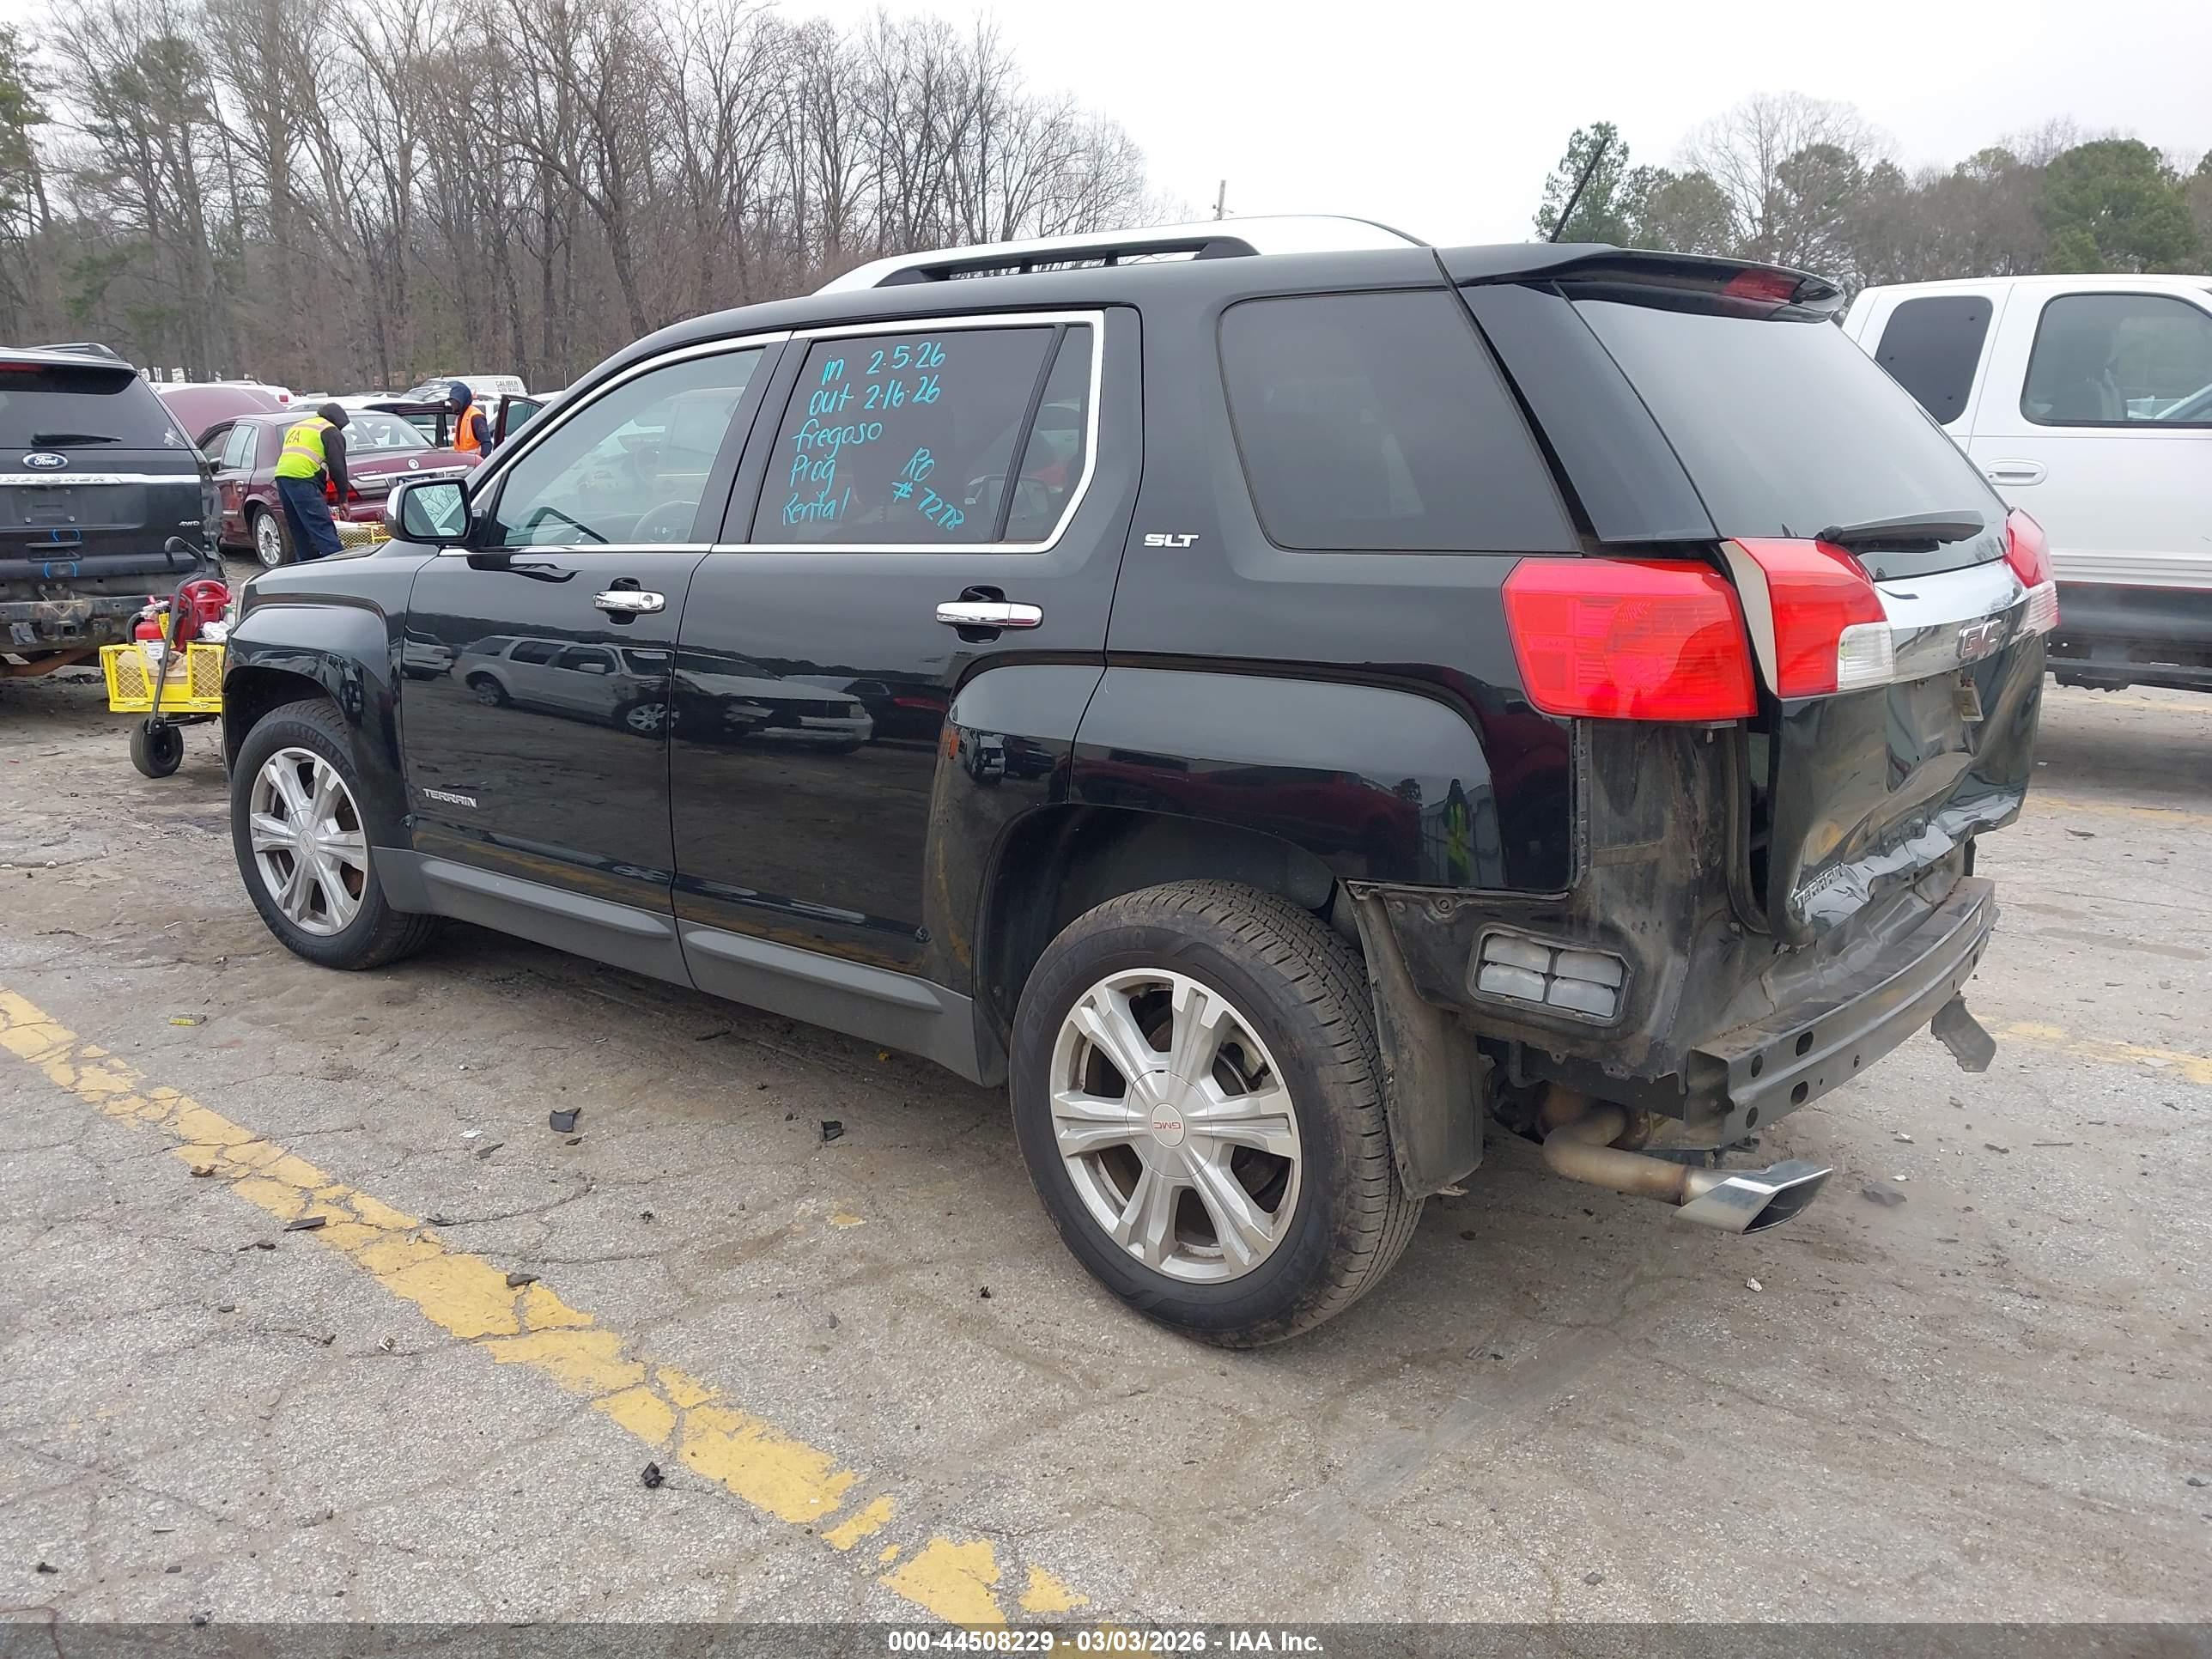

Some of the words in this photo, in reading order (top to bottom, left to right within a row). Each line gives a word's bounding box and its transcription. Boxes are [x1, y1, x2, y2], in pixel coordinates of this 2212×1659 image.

[33, 455, 58, 466] Ford
[1144, 533, 1200, 548] SLT
[422, 787, 477, 807] TERRAIN
[1153, 1121, 1182, 1130] GMC
